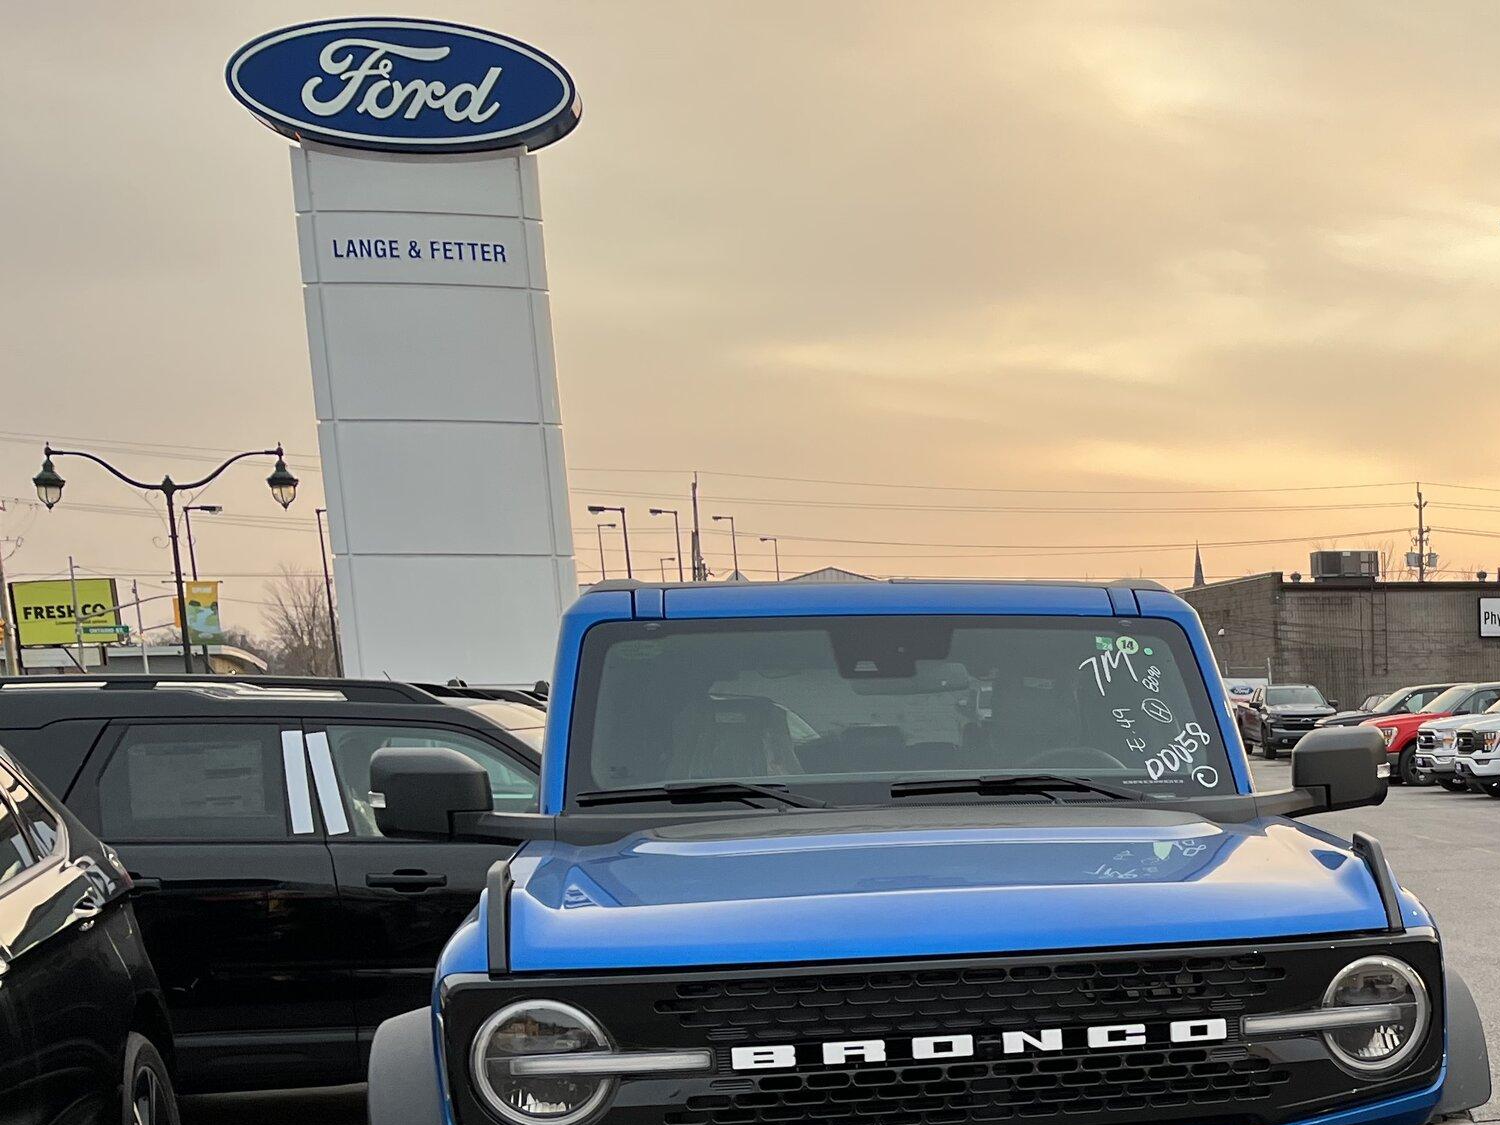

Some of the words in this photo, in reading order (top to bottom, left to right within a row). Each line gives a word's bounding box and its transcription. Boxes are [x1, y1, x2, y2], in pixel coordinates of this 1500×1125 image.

[301, 38, 502, 124] Ford
[332, 239, 400, 258] LANGE
[408, 241, 421, 258] &
[430, 241, 507, 263] FETTER
[1121, 640, 1134, 650] 14
[731, 1018, 1227, 1071] BRONCO
